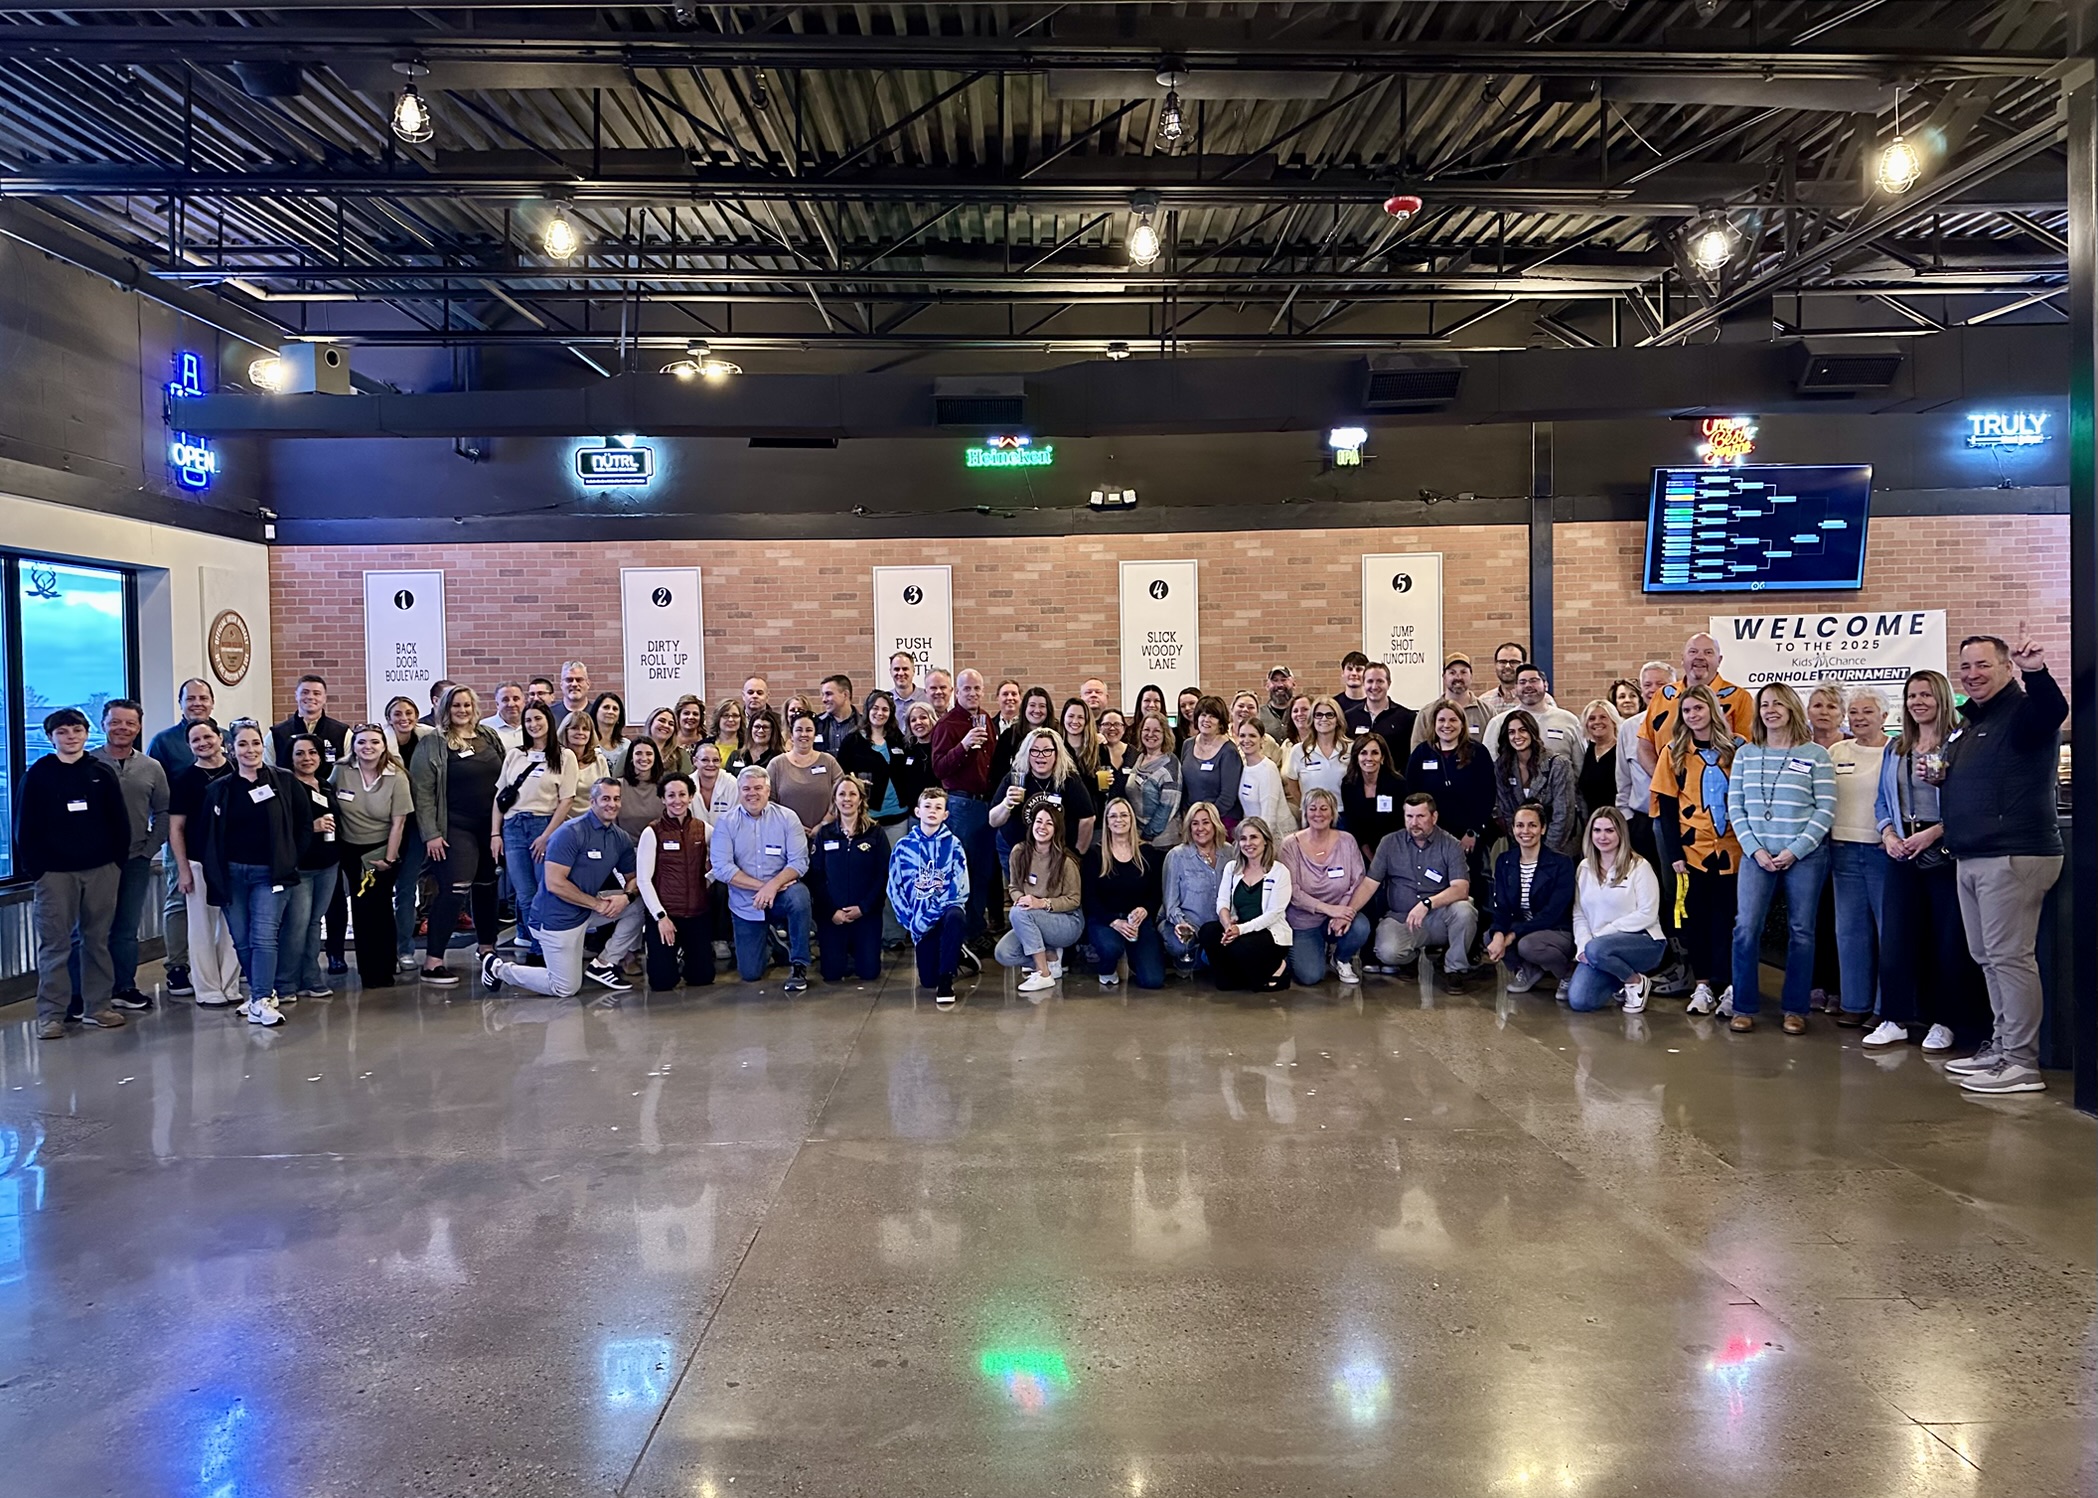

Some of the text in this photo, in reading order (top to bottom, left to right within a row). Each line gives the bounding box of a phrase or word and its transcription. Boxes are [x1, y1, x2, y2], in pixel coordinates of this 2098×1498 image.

[1967, 413, 2048, 435] TRULY
[173, 443, 215, 473] OPEN
[966, 447, 1053, 467] Heineken
[1337, 449, 1360, 466] IPA
[1396, 574, 1407, 592] 5
[908, 585, 919, 604] 3
[1153, 581, 1164, 599] 4
[657, 588, 667, 606] 2
[1391, 625, 1415, 637] JUMP
[1733, 613, 1926, 640] WELCOME
[896, 637, 932, 649] PUSH
[1147, 631, 1177, 643] SLICK
[395, 642, 417, 654] BACK
[647, 640, 680, 652] DIRTY
[1141, 645, 1183, 656] WOODY
[1391, 639, 1414, 651] SHOT
[1775, 639, 1880, 652] TO THE 2025
[396, 656, 418, 668] DOOR
[640, 653, 688, 666] ROLL UP
[911, 651, 929, 662] AG
[1382, 652, 1425, 665] JUNCTION
[1828, 656, 1867, 666] Chance
[1148, 658, 1177, 670] LANE
[385, 669, 430, 682] BOULEVARD
[648, 667, 681, 680] DRIVE
[1748, 667, 1909, 683] CORNHOLE TOURNAMENT
